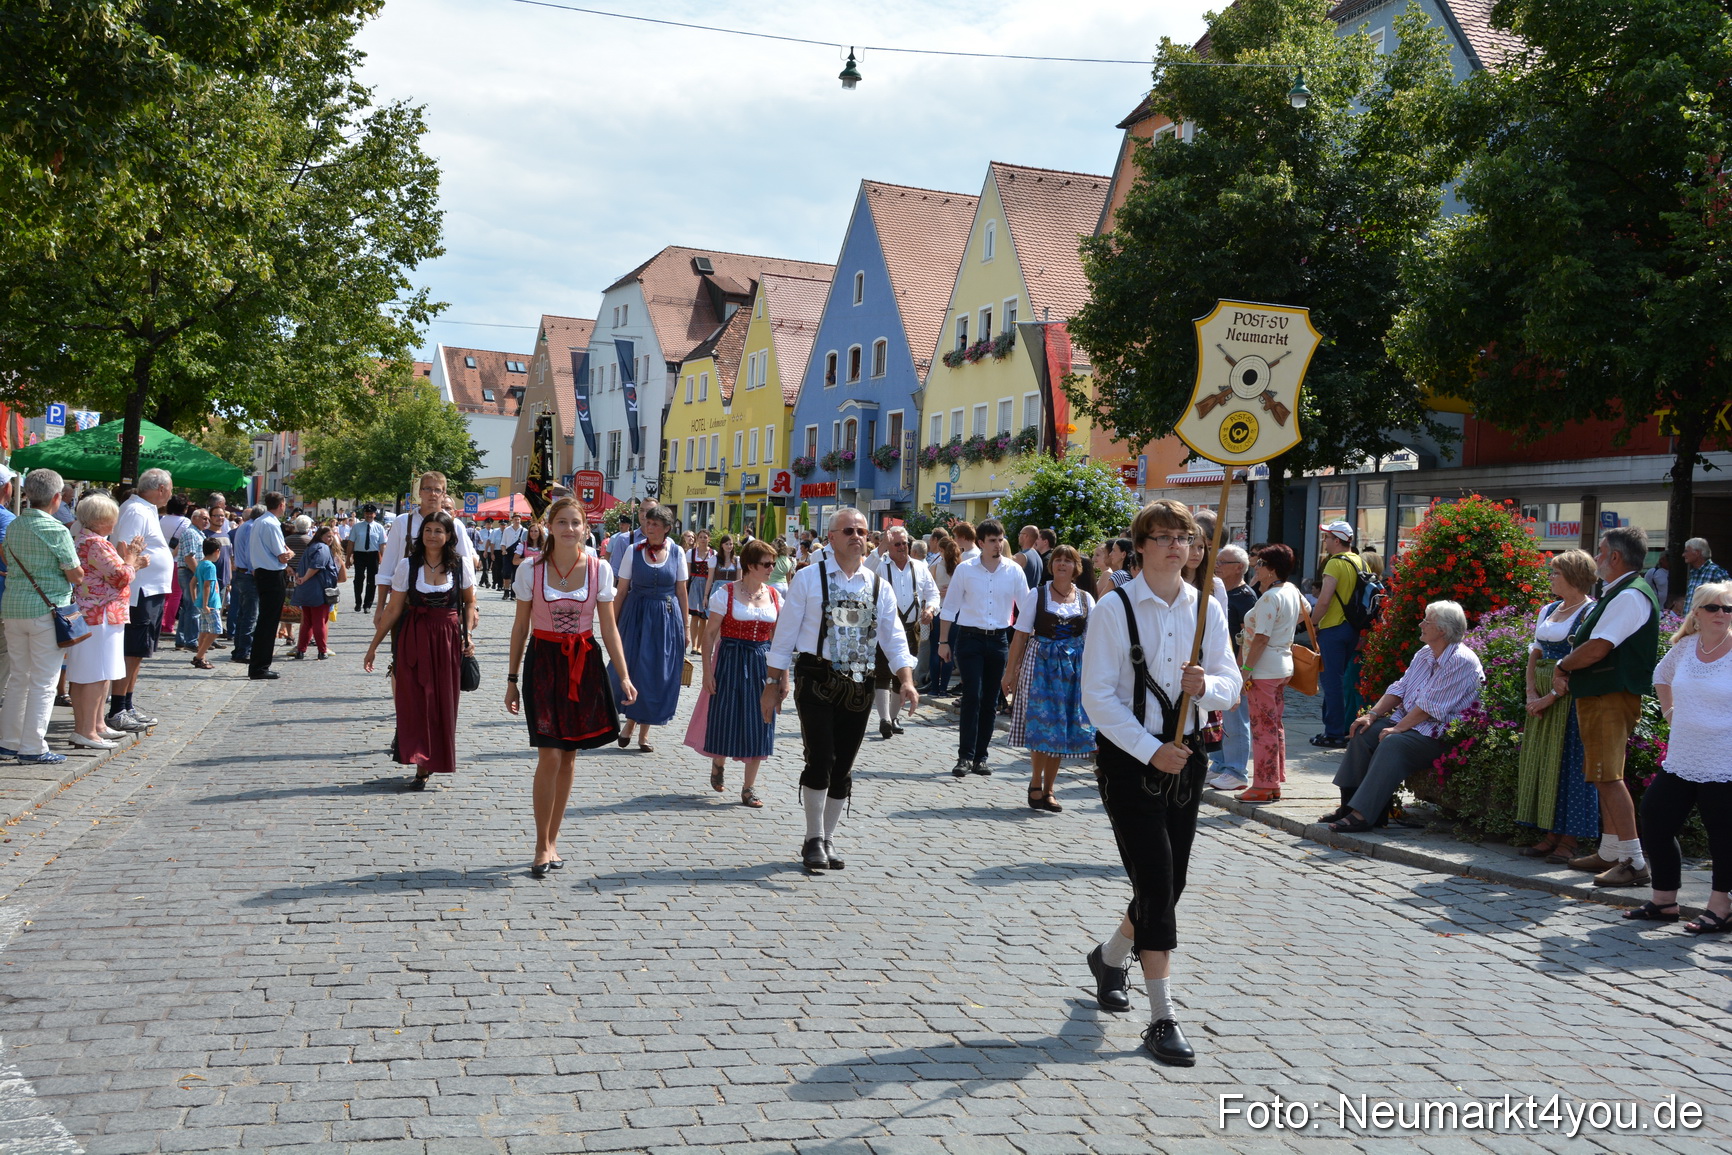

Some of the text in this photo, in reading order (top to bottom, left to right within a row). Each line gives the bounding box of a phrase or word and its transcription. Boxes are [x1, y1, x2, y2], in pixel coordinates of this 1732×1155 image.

[1226, 327, 1289, 346] Neumarkt
[50, 405, 61, 423] P
[691, 418, 706, 432] HOTEL
[800, 482, 837, 498] APOTHEKE
